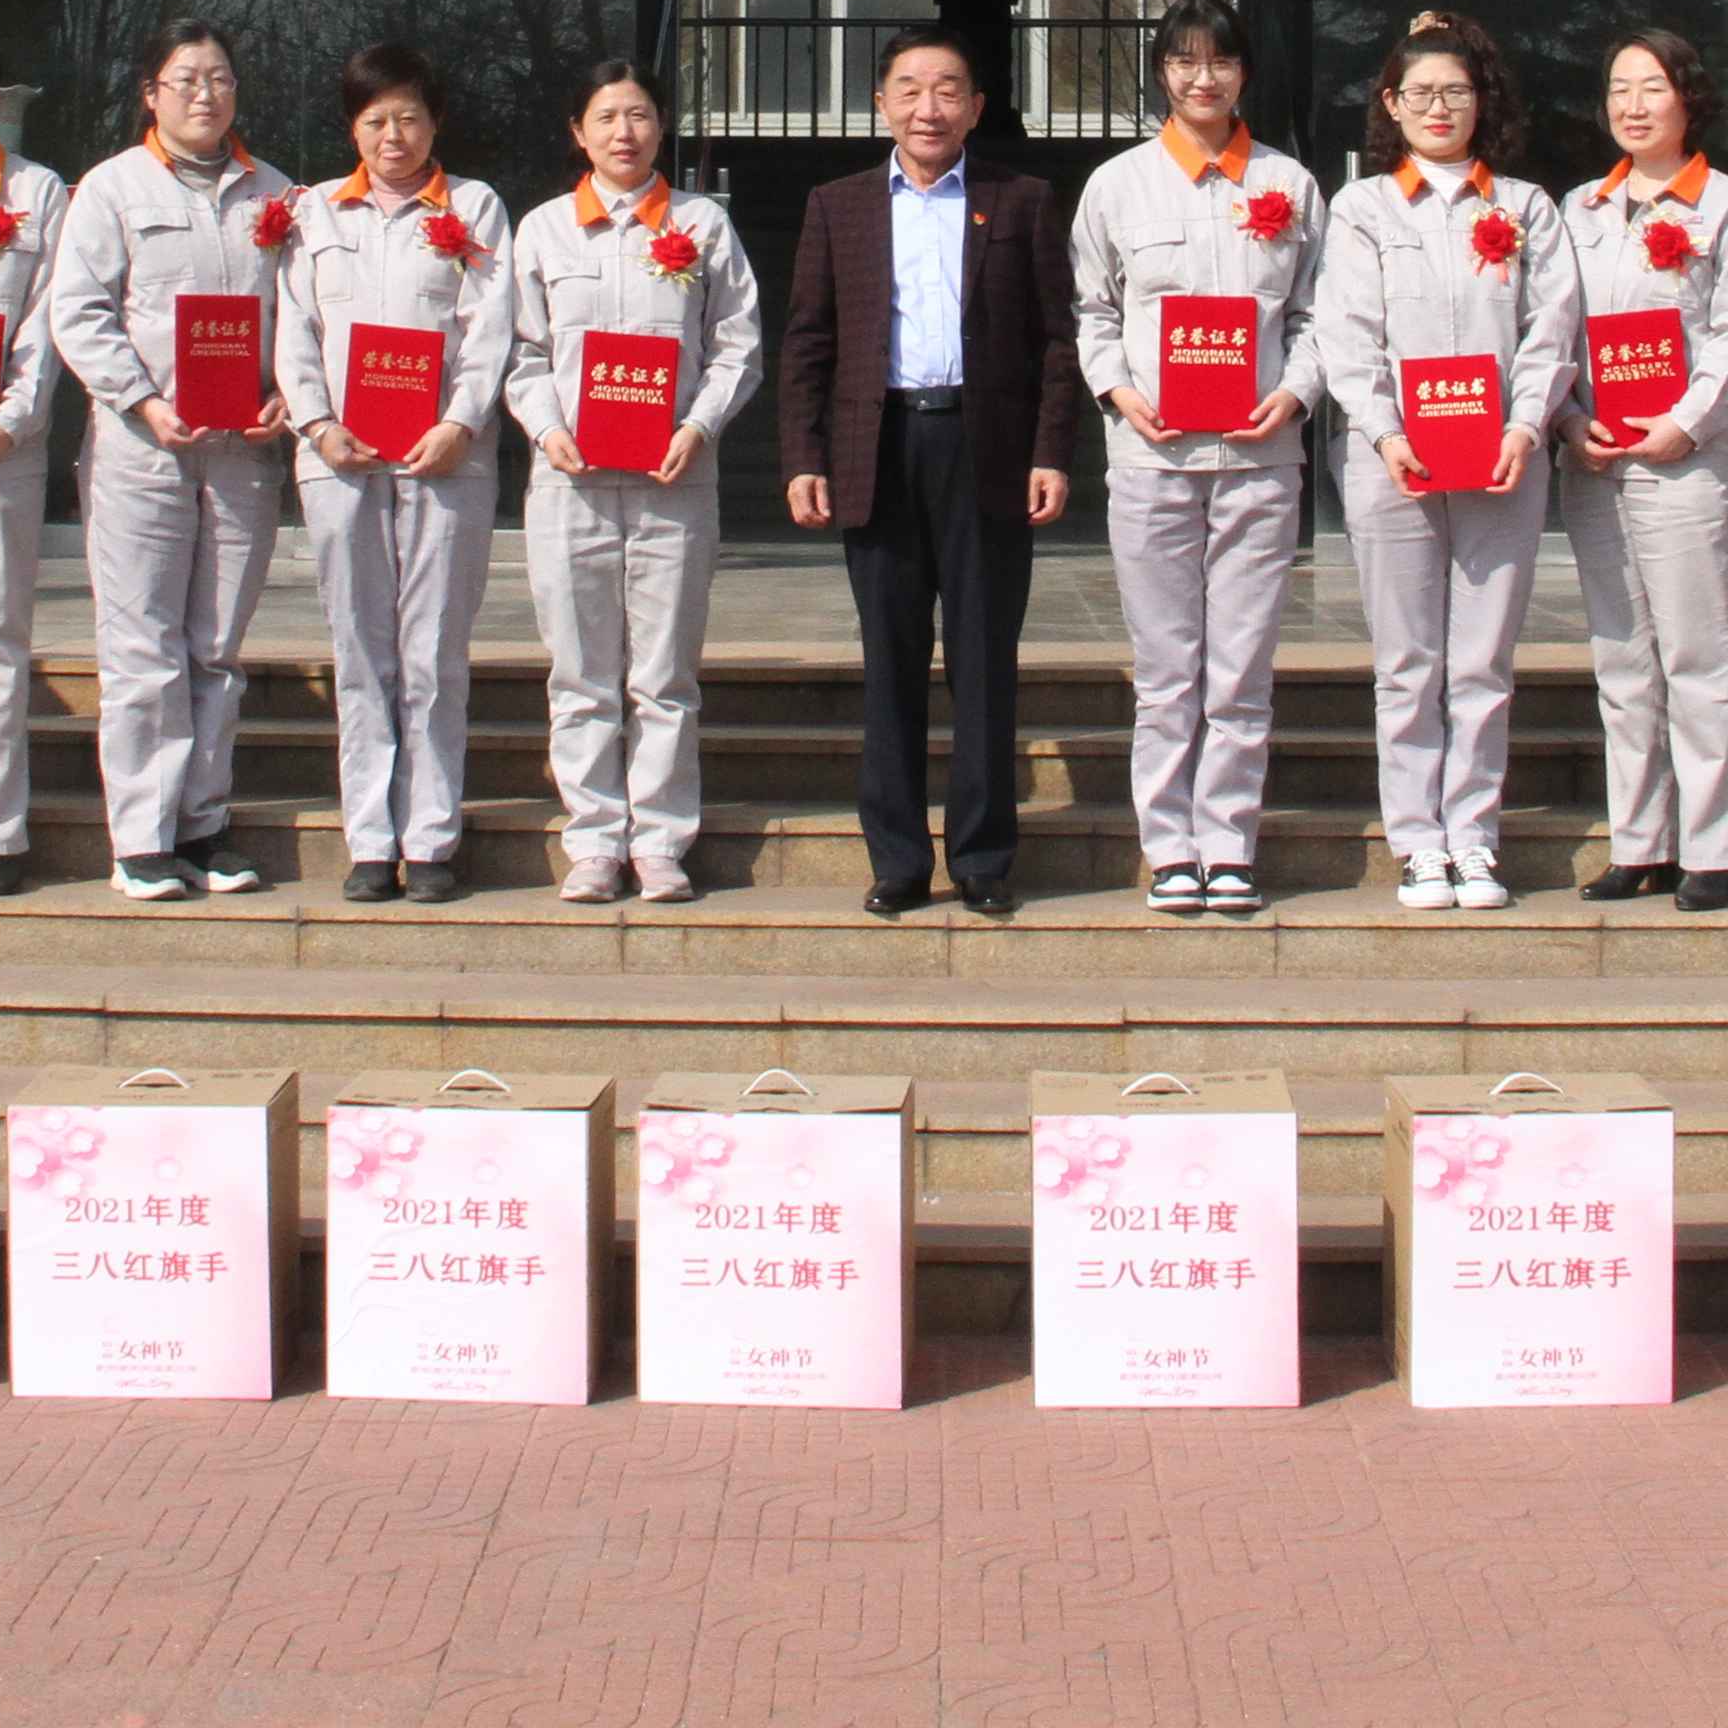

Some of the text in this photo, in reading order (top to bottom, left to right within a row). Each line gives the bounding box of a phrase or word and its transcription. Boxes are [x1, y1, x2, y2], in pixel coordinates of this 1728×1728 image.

[190, 320, 251, 338] 荣誉证书
[1169, 326, 1248, 347] 荣誉证书
[362, 350, 431, 372] 荣誉证书
[1169, 355, 1247, 365] CREDENTIAL
[1599, 338, 1672, 364] 荣誉证书
[590, 362, 669, 385] 荣誉证书
[1601, 369, 1676, 383] CREDENTIAL
[1604, 361, 1670, 374] HONORARY
[589, 391, 667, 405] CREDENTIAL
[594, 385, 663, 396] HONORARY
[1416, 378, 1486, 400] 荣誉证书
[1417, 408, 1488, 417] CREDENTIAL
[1420, 401, 1483, 410] HONORARY
[64, 1193, 210, 1227] 2021年度
[383, 1195, 529, 1230] 2021年度
[692, 1200, 843, 1234] 2021年度
[1090, 1200, 1239, 1234] 2021年度
[1468, 1200, 1615, 1233] 2021年度
[53, 1250, 229, 1283] 三八红旗手
[367, 1252, 546, 1287] 三八红旗手
[681, 1257, 860, 1291] 三八红旗手
[1076, 1258, 1256, 1291] 三八红旗手
[1453, 1256, 1632, 1289] 三八红旗手
[119, 1340, 183, 1361] 女神节
[434, 1342, 499, 1363] 女神节
[747, 1347, 812, 1368] 女神节
[1143, 1347, 1209, 1369] 女神节
[1520, 1347, 1584, 1368] 女神节
